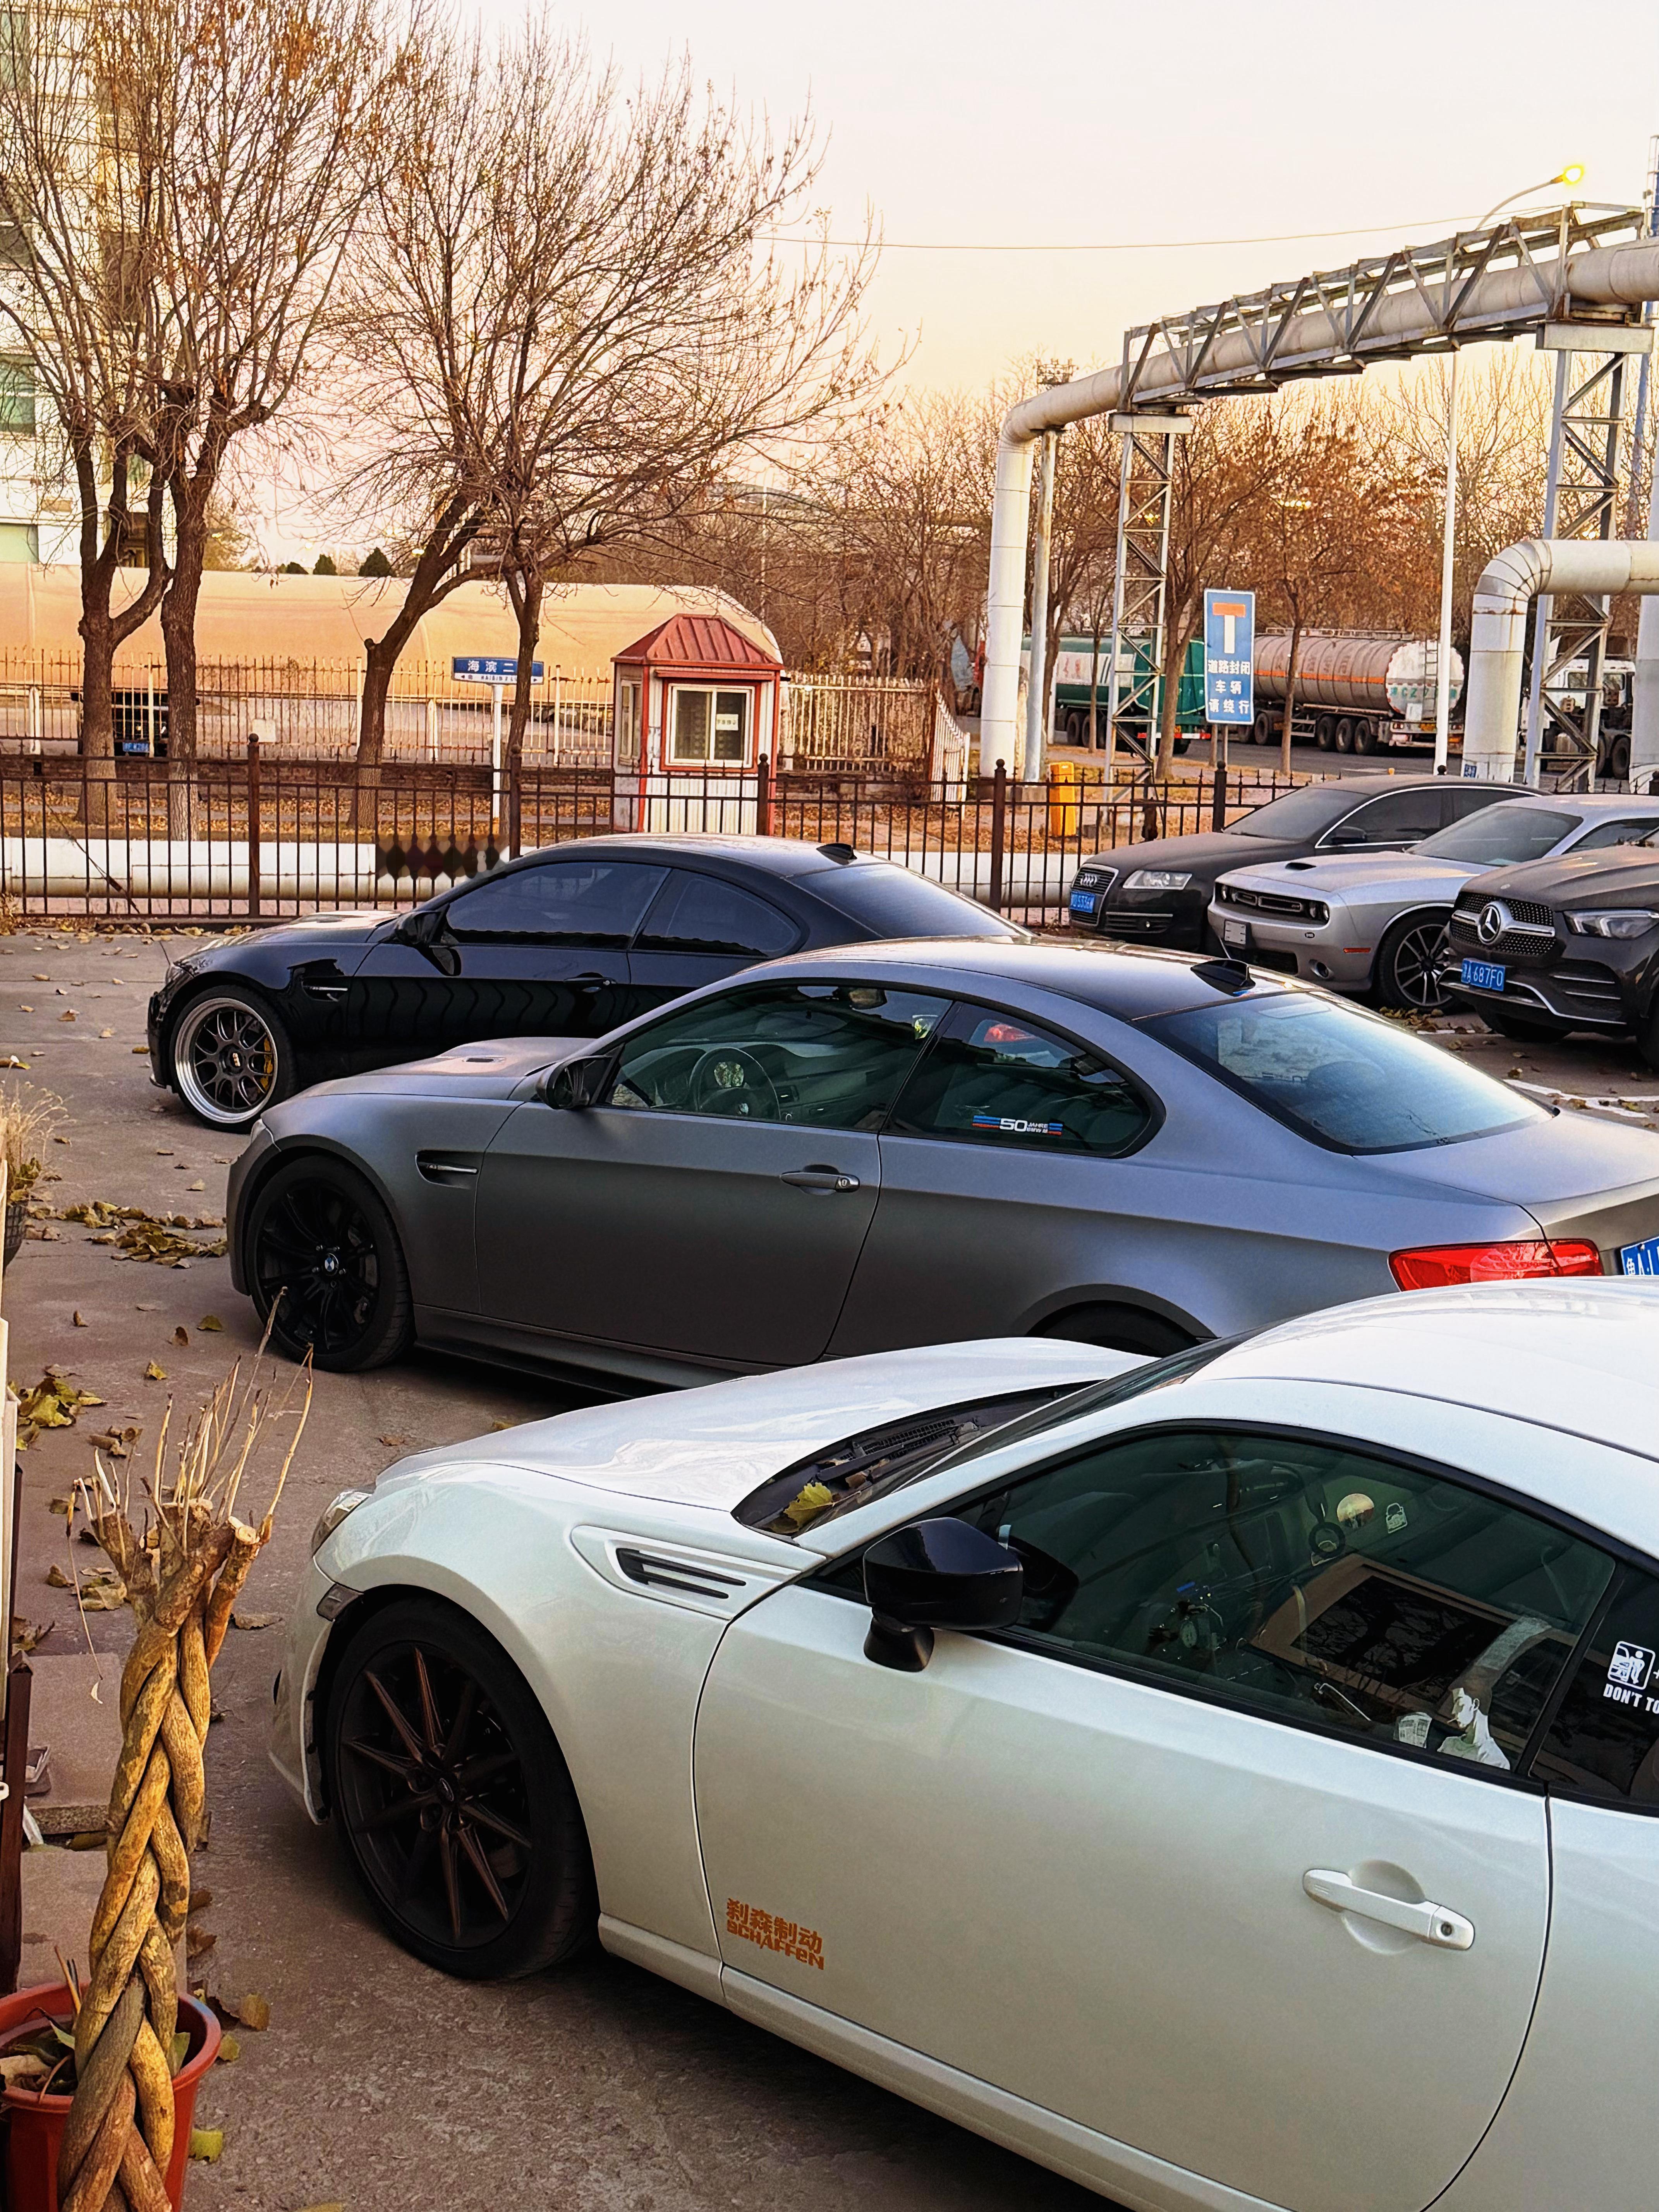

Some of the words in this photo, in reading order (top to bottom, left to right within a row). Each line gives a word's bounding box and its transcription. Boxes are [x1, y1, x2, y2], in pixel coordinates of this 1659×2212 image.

[467, 660, 514, 673] 海滨二
[1208, 659, 1250, 675] 道路封闭
[1215, 680, 1242, 694] 车辆
[1209, 699, 1249, 714] 请绕行
[1000, 1118, 1028, 1132] 50
[1603, 1683, 1642, 1707] DON'T
